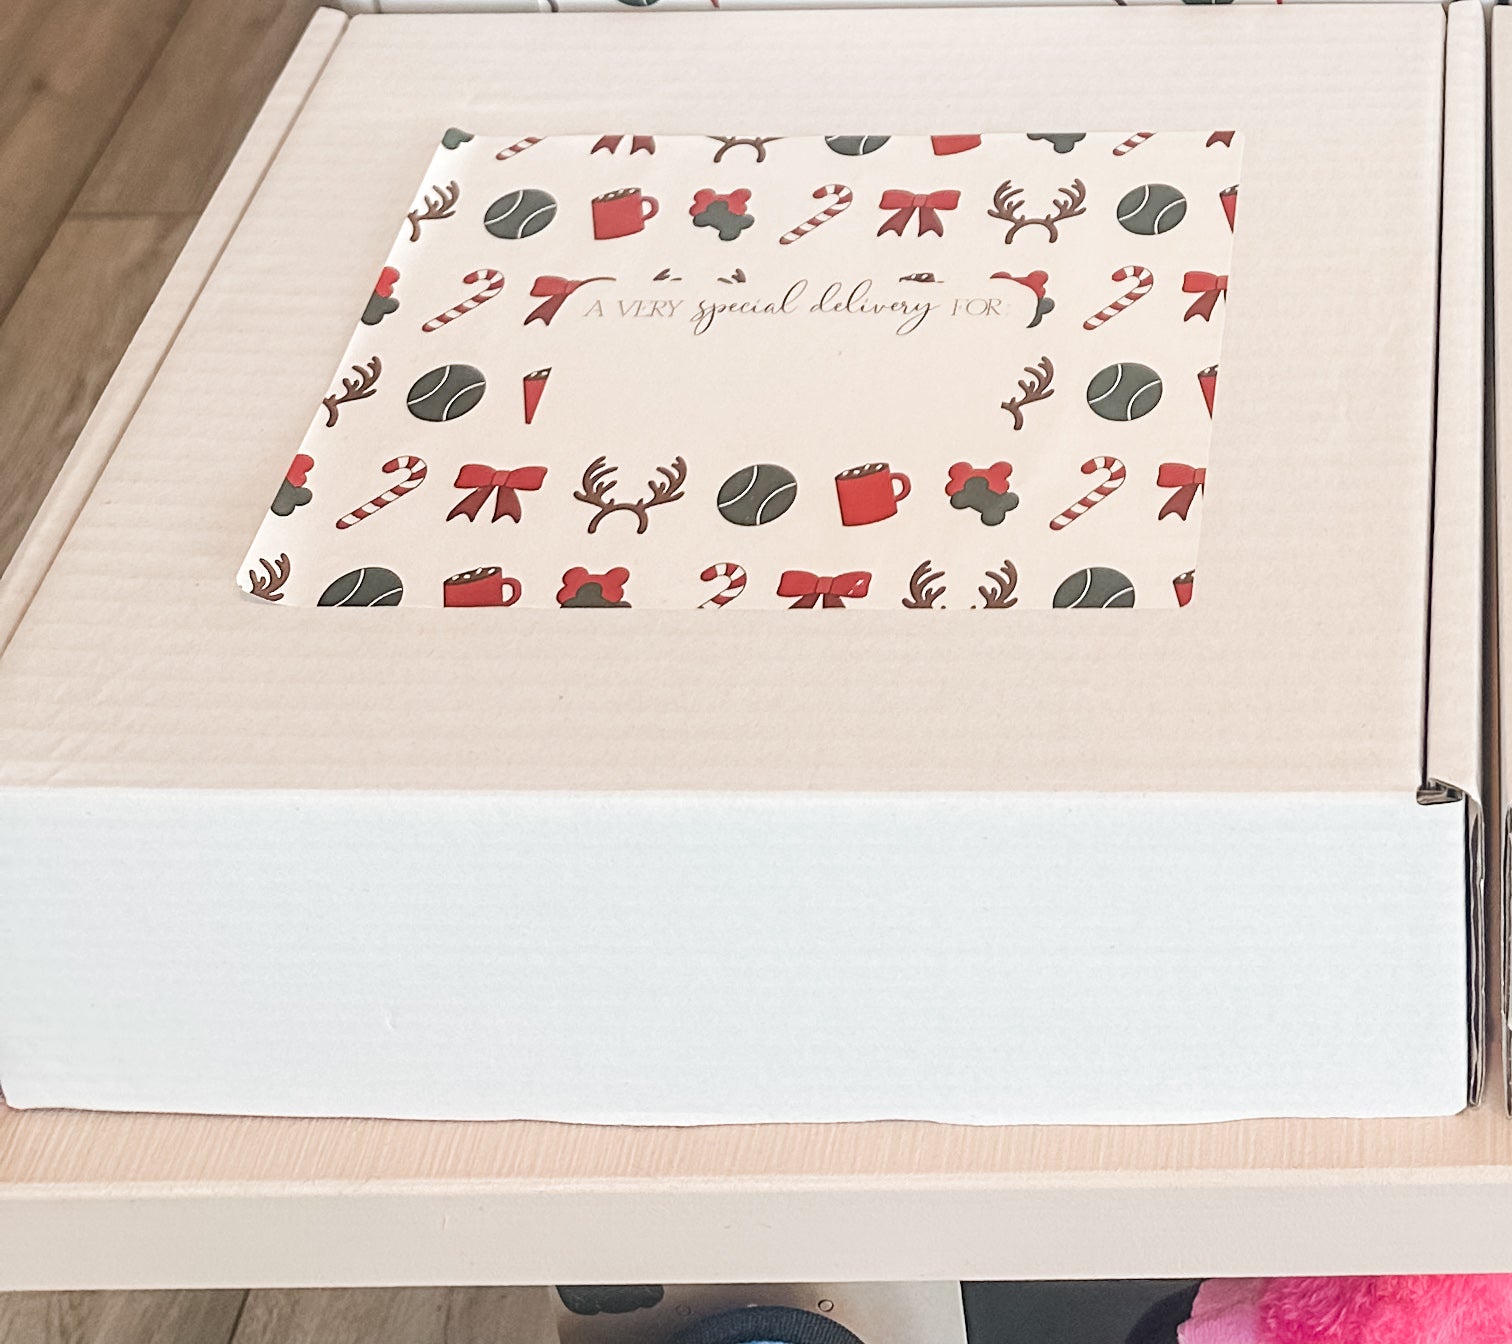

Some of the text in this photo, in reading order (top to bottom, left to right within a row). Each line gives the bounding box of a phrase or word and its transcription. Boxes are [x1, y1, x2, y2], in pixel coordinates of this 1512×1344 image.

[584, 298, 605, 317] A
[617, 298, 684, 317] VERY
[690, 279, 808, 335] special
[810, 279, 936, 335] delivery
